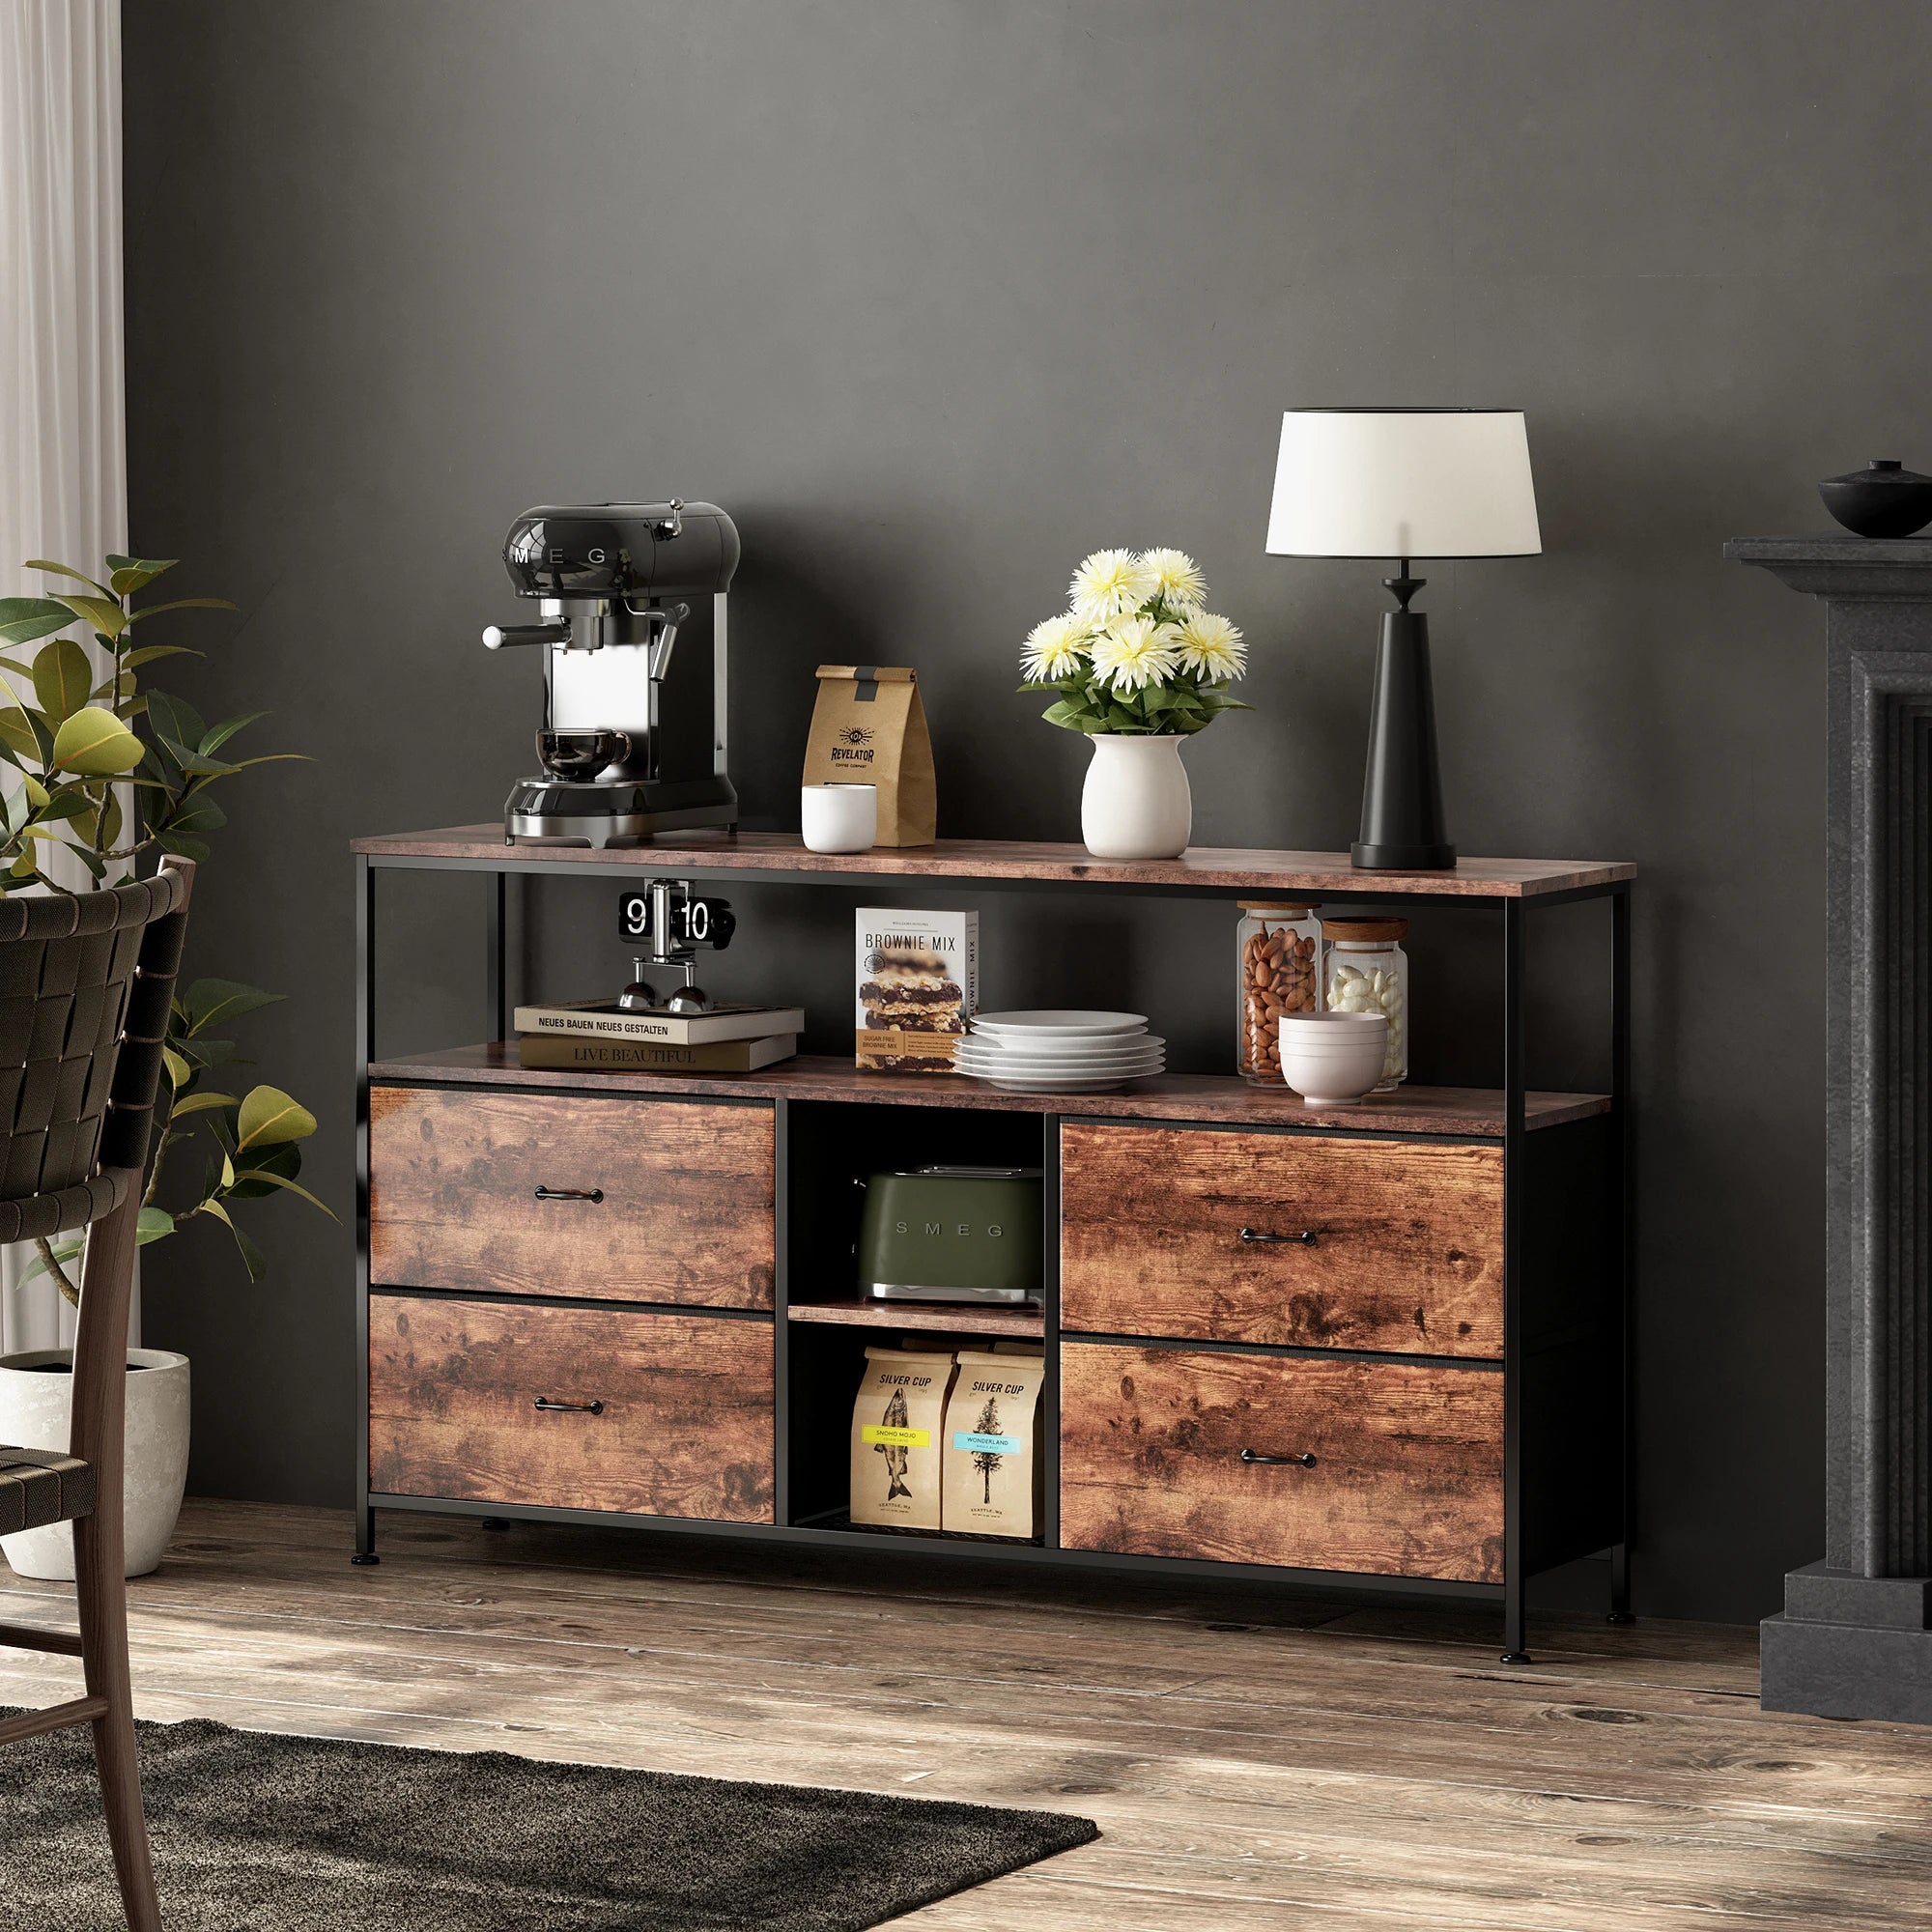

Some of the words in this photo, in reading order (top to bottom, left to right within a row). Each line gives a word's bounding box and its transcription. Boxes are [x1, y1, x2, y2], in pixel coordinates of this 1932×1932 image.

[831, 747, 874, 763] REVELATOR
[627, 898, 646, 934] 9
[681, 901, 708, 940] 10
[866, 933, 924, 951] BROWNIE
[932, 936, 955, 952] MIX
[538, 1017, 564, 1028] NEUES
[567, 1019, 594, 1030] BAUEN
[596, 1021, 622, 1032] NEUES
[624, 1023, 668, 1036] GESTALTEN
[575, 1048, 608, 1061] LIVE
[611, 1048, 696, 1064] BEAUTIFUL
[895, 1221, 1003, 1237] SMEG
[879, 1374, 911, 1385] SILVER
[912, 1377, 932, 1387] CUP
[972, 1381, 1003, 1393] SILVER
[1005, 1384, 1024, 1395] CUP
[967, 1436, 1009, 1446] WONDERLAND
